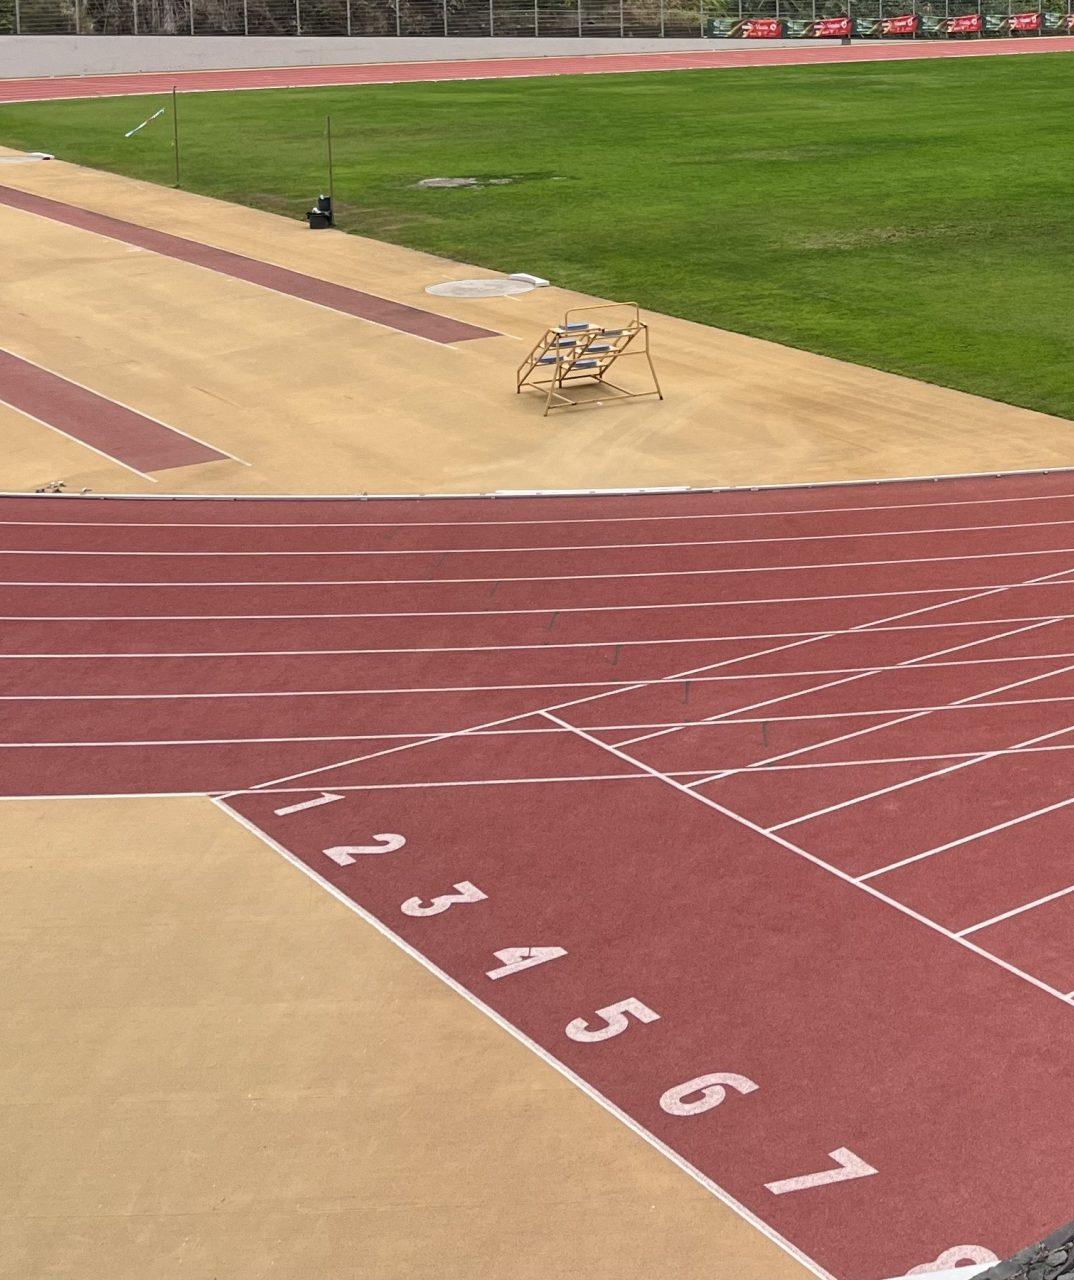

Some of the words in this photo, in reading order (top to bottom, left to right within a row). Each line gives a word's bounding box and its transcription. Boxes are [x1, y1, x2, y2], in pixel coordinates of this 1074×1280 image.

[273, 791, 346, 816] 1
[322, 832, 407, 867] 2
[400, 880, 489, 917] 3
[485, 945, 568, 981] 4
[565, 996, 661, 1043] 5
[659, 1072, 760, 1117] 6
[763, 1146, 879, 1195] 7
